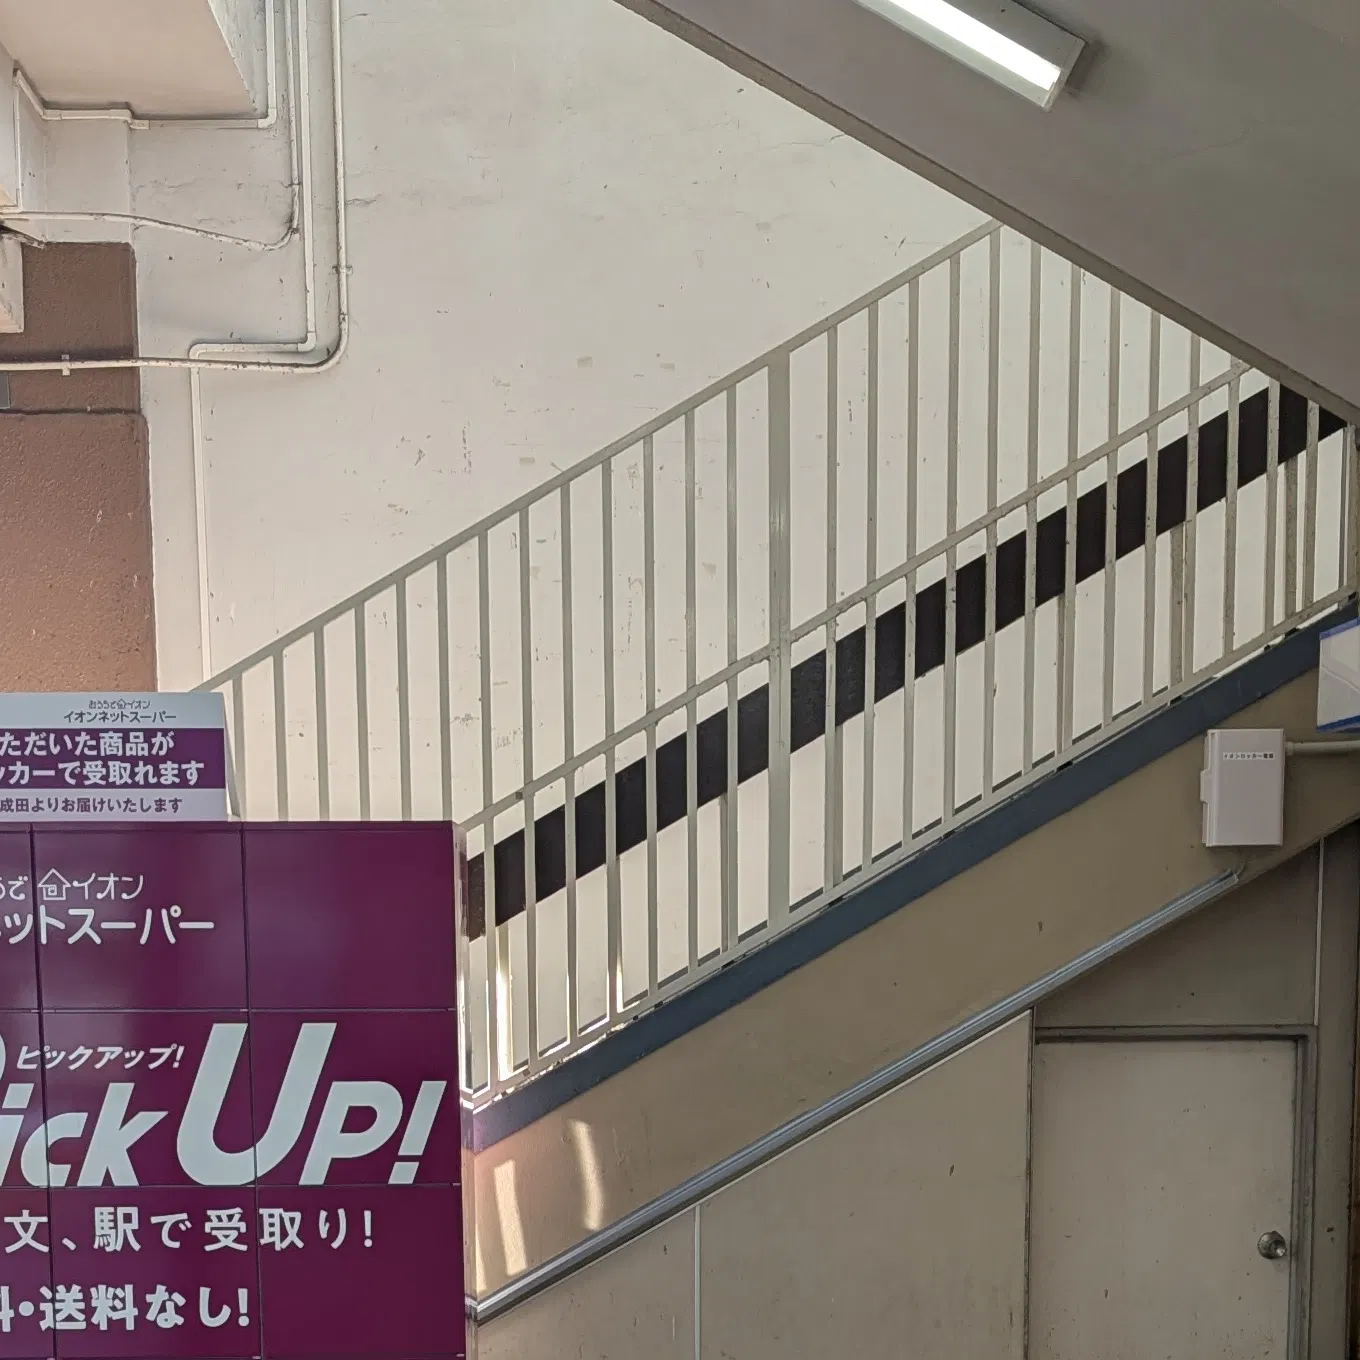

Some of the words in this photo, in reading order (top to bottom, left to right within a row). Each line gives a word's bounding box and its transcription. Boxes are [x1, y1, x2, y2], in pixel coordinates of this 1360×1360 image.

[63, 710, 177, 724] イオンネットスーパー
[15, 1044, 184, 1071] ピックアップ!
